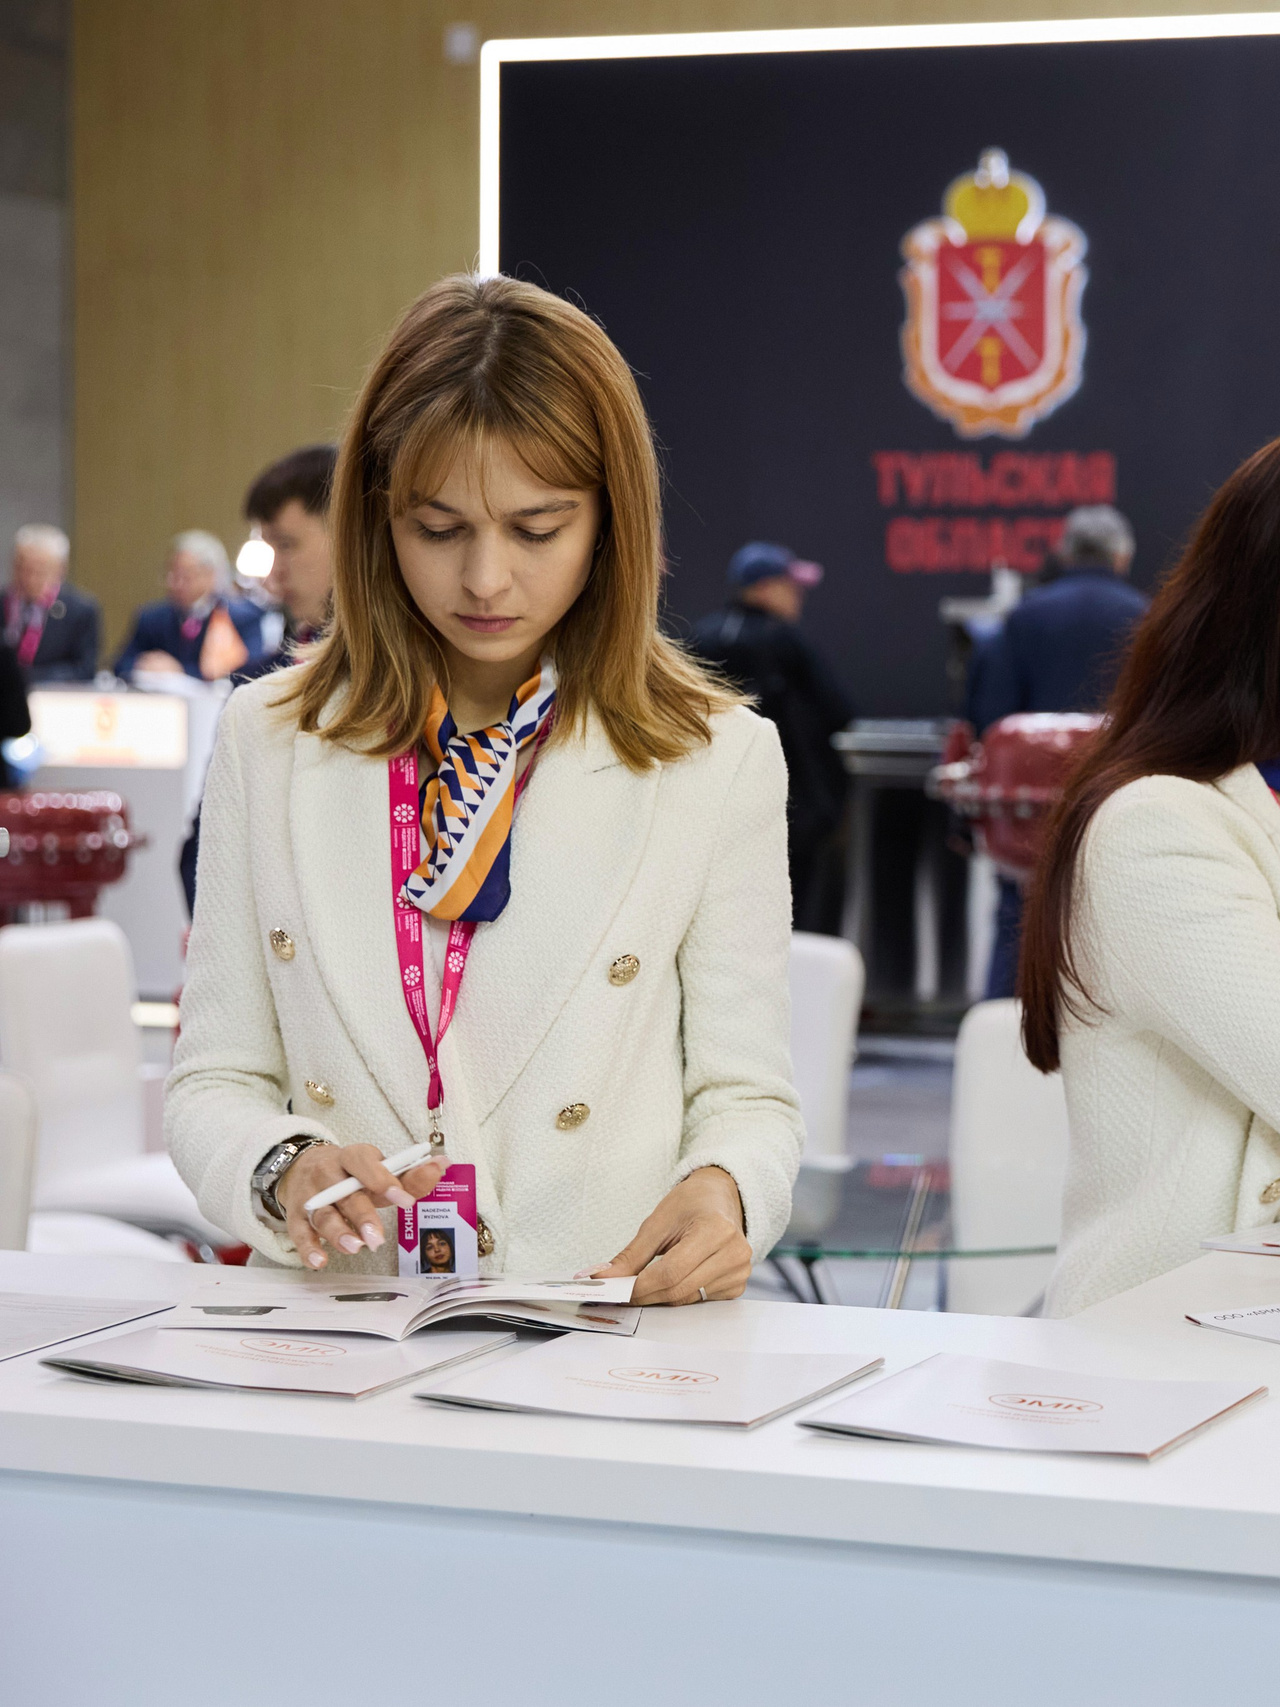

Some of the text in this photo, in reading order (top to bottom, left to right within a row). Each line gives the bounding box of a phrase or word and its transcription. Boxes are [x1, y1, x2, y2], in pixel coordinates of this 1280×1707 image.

[872, 450, 1116, 508] ТУЛЬСКАЯ
[886, 516, 1066, 573] ОБЛАС
[1213, 1313, 1244, 1321] ООО
[620, 1369, 709, 1383] ЭМК
[1000, 1396, 1090, 1411] ЭМК
